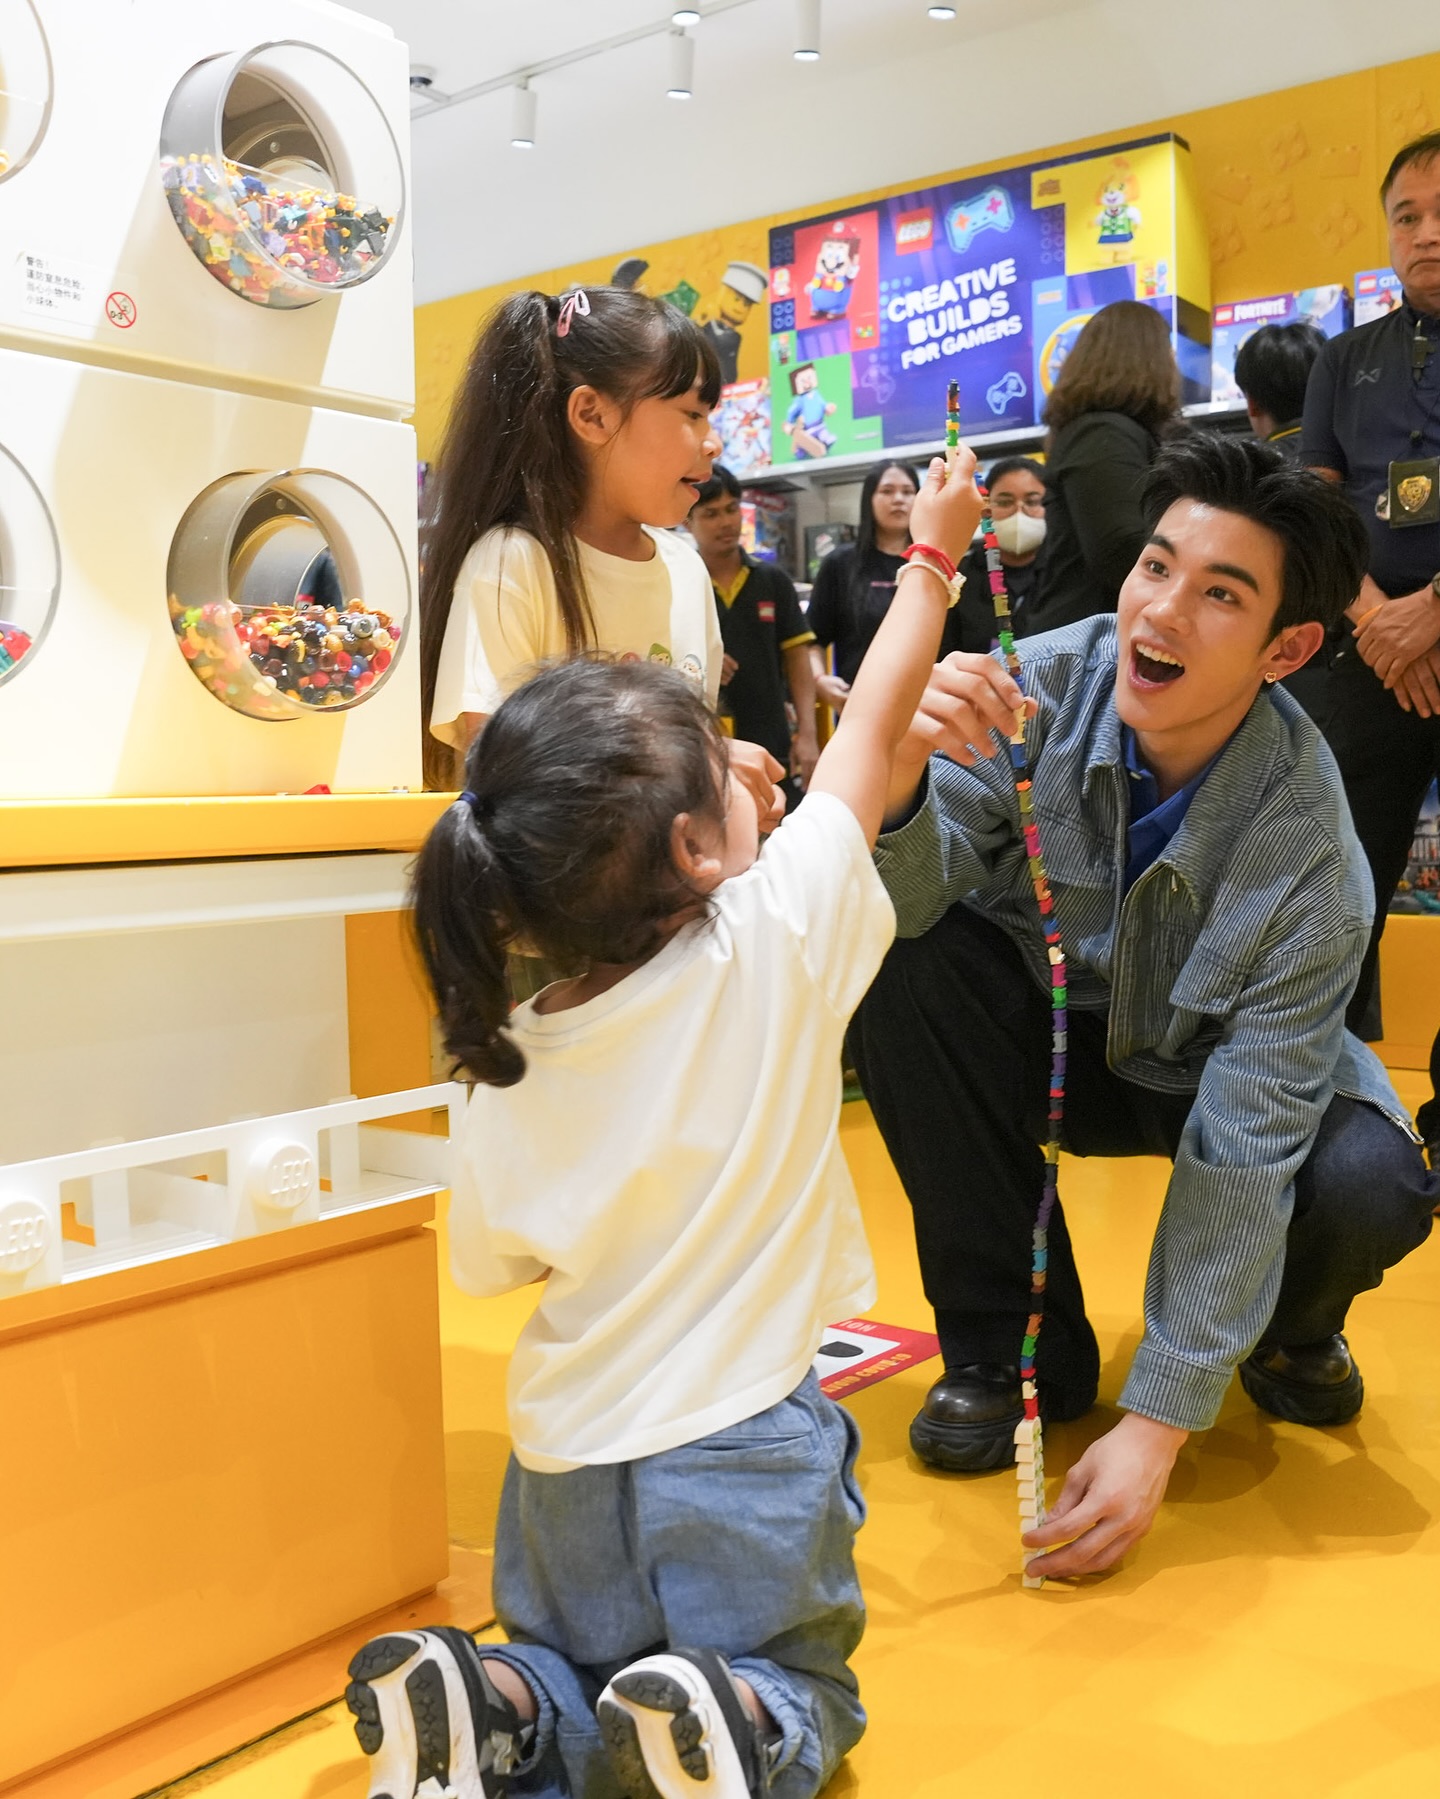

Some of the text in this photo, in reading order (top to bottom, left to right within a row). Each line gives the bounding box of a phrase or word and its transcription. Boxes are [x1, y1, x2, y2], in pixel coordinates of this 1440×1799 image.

[887, 257, 1017, 323] CREATIVE
[1378, 274, 1403, 288] CIT
[901, 315, 1023, 370] FOR GAMERS
[907, 290, 1010, 346] BUILDS
[270, 1159, 310, 1195] LEGO
